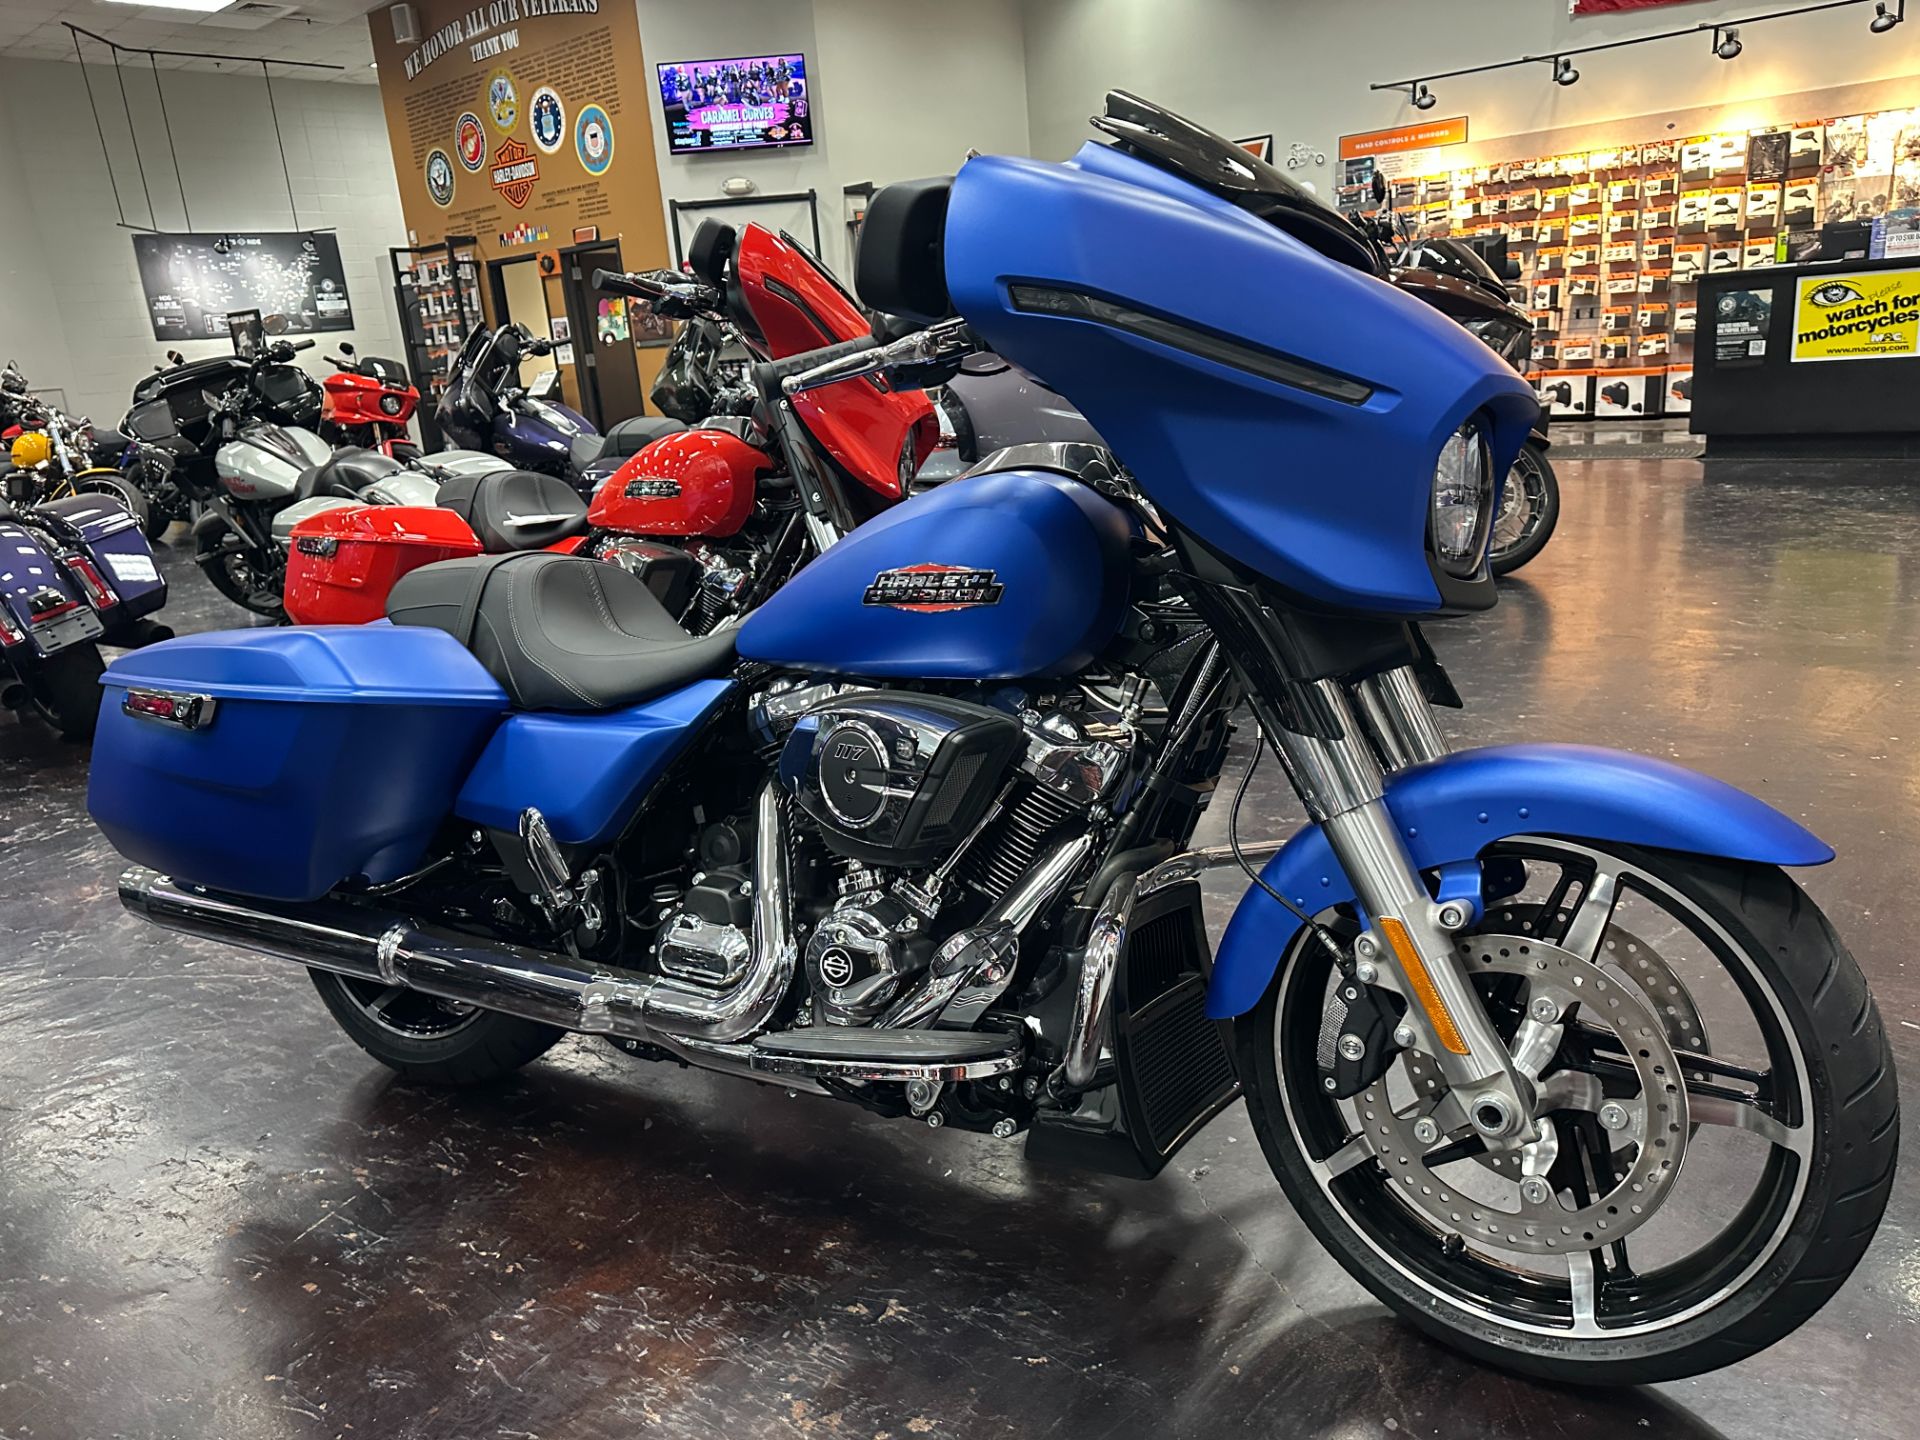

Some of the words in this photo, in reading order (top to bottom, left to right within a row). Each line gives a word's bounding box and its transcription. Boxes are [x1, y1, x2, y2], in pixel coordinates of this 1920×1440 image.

[403, 51, 423, 81] WE
[421, 20, 463, 65] HONOR
[465, 8, 490, 39] ALL
[489, 0, 519, 28] OUR
[522, 0, 599, 18] VETERANS
[470, 35, 501, 63] THANK
[499, 28, 519, 52] YOU
[700, 109, 740, 124] CARAMEL
[741, 106, 774, 122] CURVES
[1355, 142, 1373, 150] HAND
[1375, 136, 1409, 147] CONTROLS
[1418, 130, 1450, 140] MIRRORS
[500, 145, 525, 163] MOTOR
[506, 182, 528, 202] CYCLES
[1868, 280, 1903, 302] please
[1826, 299, 1888, 323] watch
[1892, 293, 1920, 310] for
[1798, 309, 1920, 344] motorcycles
[1870, 332, 1903, 343] MAC
[1826, 344, 1909, 354] www.macorg.com
[834, 742, 870, 761] 117
